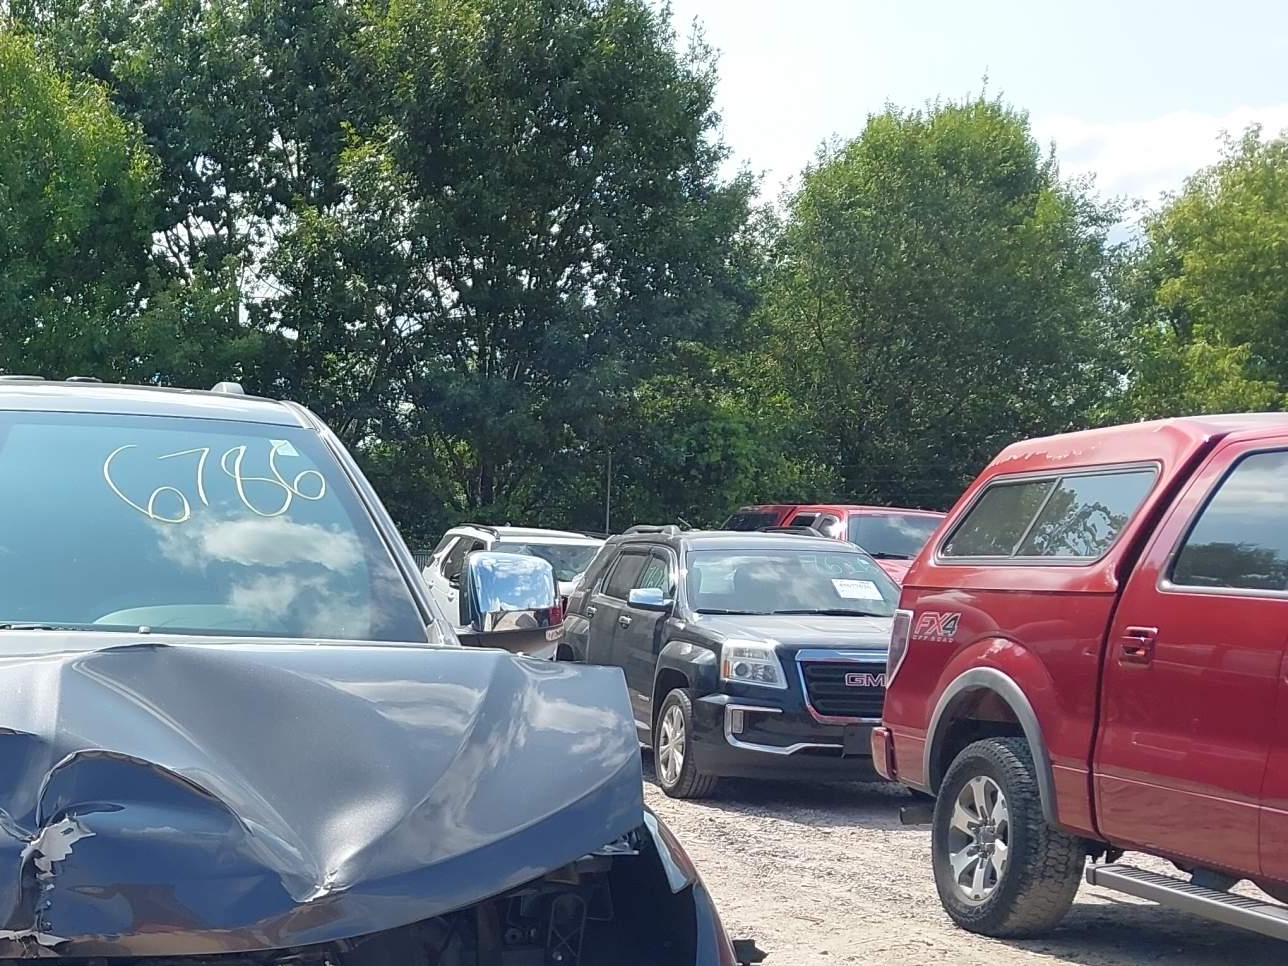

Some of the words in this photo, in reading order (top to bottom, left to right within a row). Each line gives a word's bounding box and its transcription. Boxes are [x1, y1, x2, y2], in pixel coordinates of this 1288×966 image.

[103, 444, 326, 524] 6786
[914, 611, 962, 636] FX4
[844, 672, 888, 687] GM
